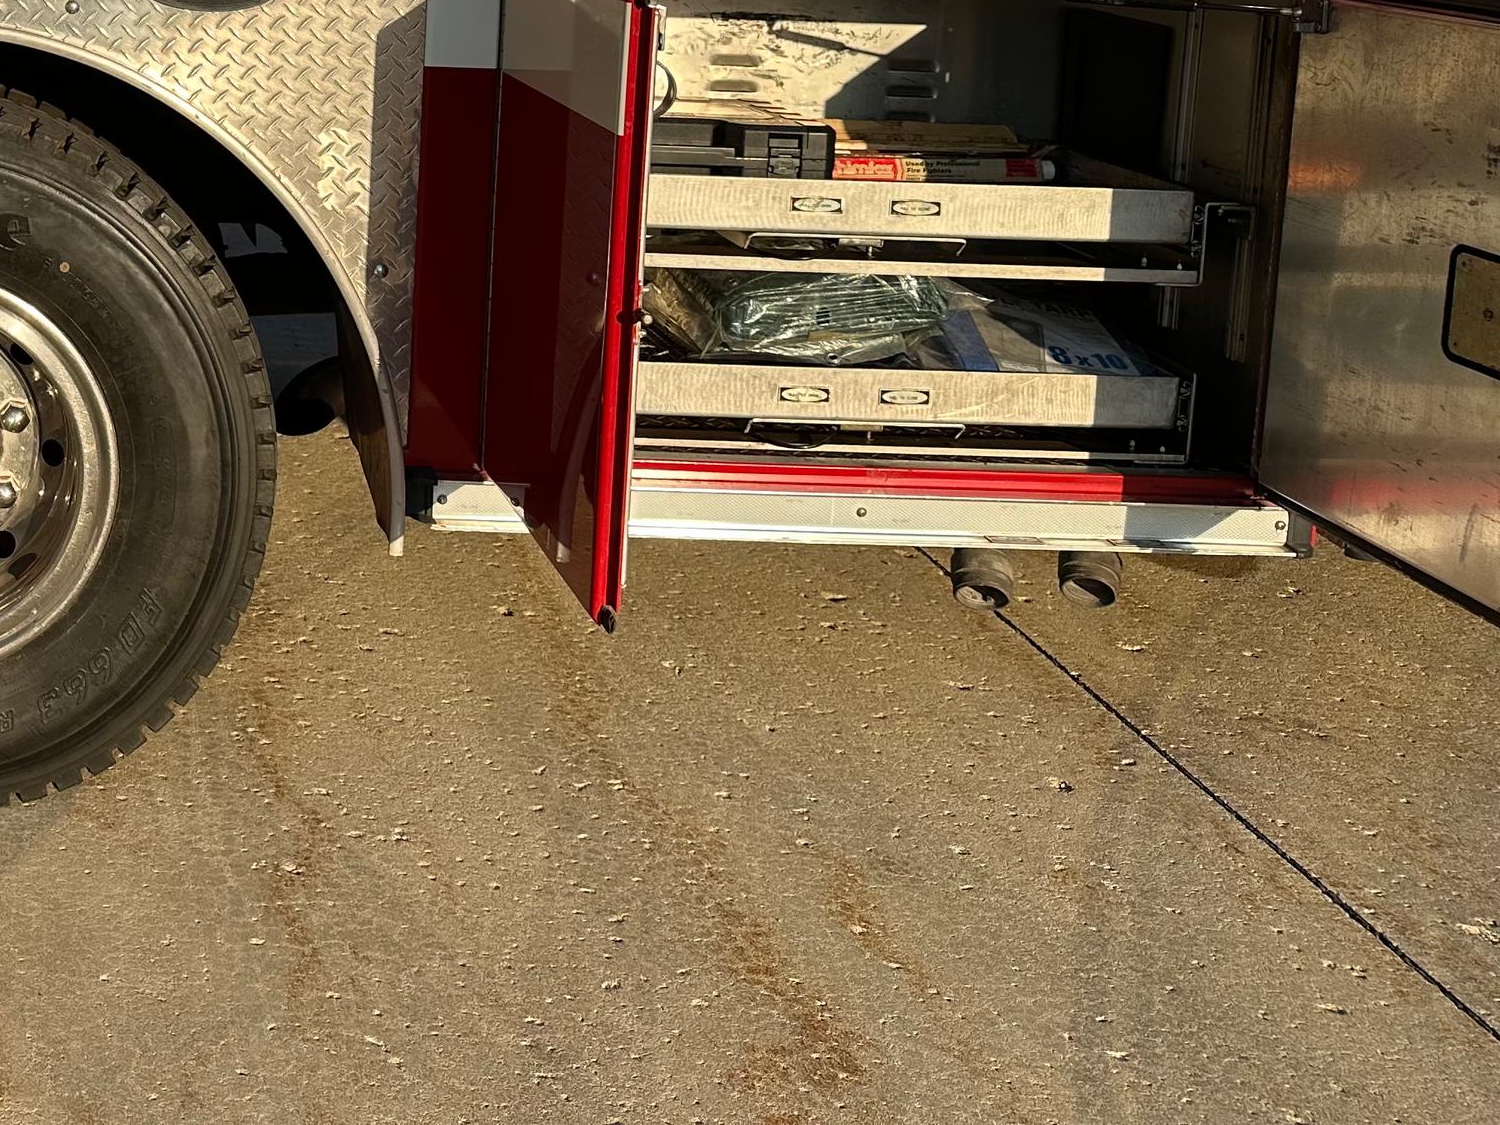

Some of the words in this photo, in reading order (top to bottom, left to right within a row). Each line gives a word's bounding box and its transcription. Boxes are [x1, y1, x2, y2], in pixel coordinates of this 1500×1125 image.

[905, 160, 924, 168] Used
[925, 160, 934, 170] by
[923, 167, 952, 176] Fighters
